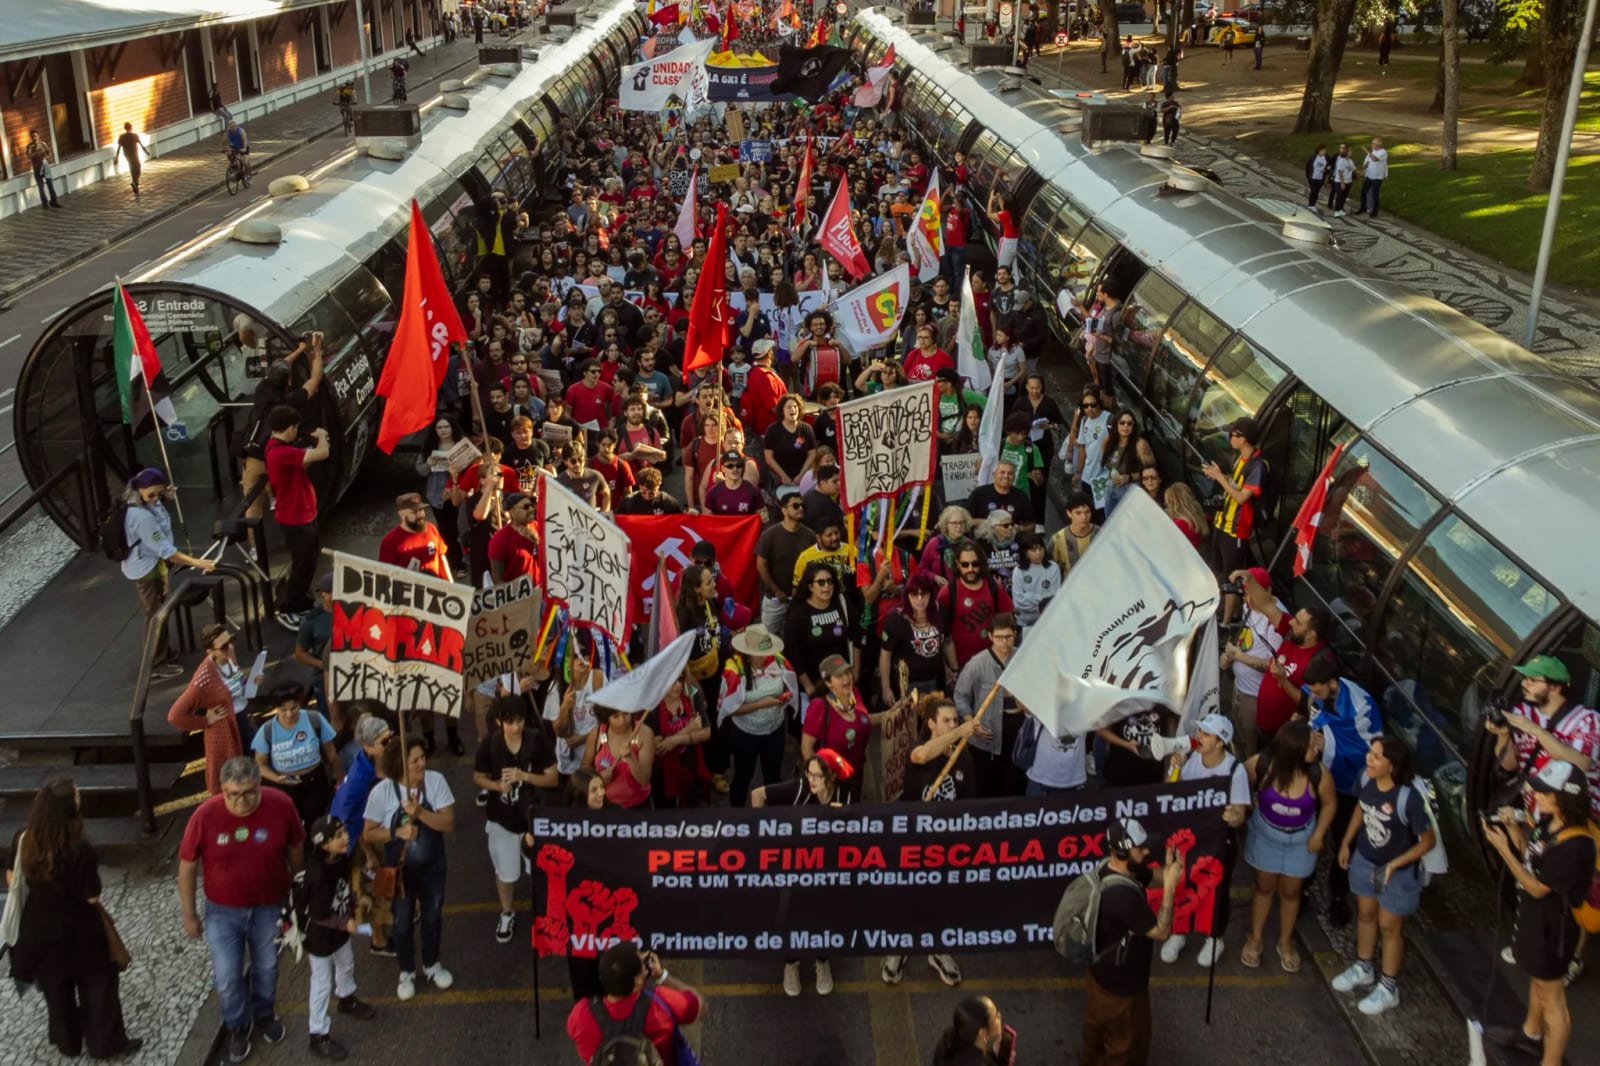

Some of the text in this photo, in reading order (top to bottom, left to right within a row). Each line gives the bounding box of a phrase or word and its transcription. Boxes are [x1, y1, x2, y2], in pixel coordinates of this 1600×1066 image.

[652, 75, 682, 85] CLASS
[157, 299, 205, 311] Entrada
[843, 408, 869, 425] POR
[857, 445, 911, 481] TARIFA
[471, 578, 531, 616] SCALA
[546, 572, 620, 640] SCIAL
[811, 610, 840, 626] PUMA
[332, 600, 465, 674] MORAR
[1081, 599, 1146, 680] Movimento de
[533, 788, 1228, 840] Exploradas/os/es Na Escala E Roubadas/os/es Na Tarifa
[648, 832, 1105, 873] PELO FIM DA ESCALA 6X
[652, 860, 1101, 888] POR UM TRASPORTE PÚBLICO E DE QUALIDAD
[652, 933, 748, 950] Primeiro
[755, 931, 783, 948] de
[790, 930, 845, 948] Maio
[851, 931, 857, 948] /
[864, 929, 913, 948] Viva
[920, 932, 934, 947] a
[941, 928, 1017, 946] Classe
